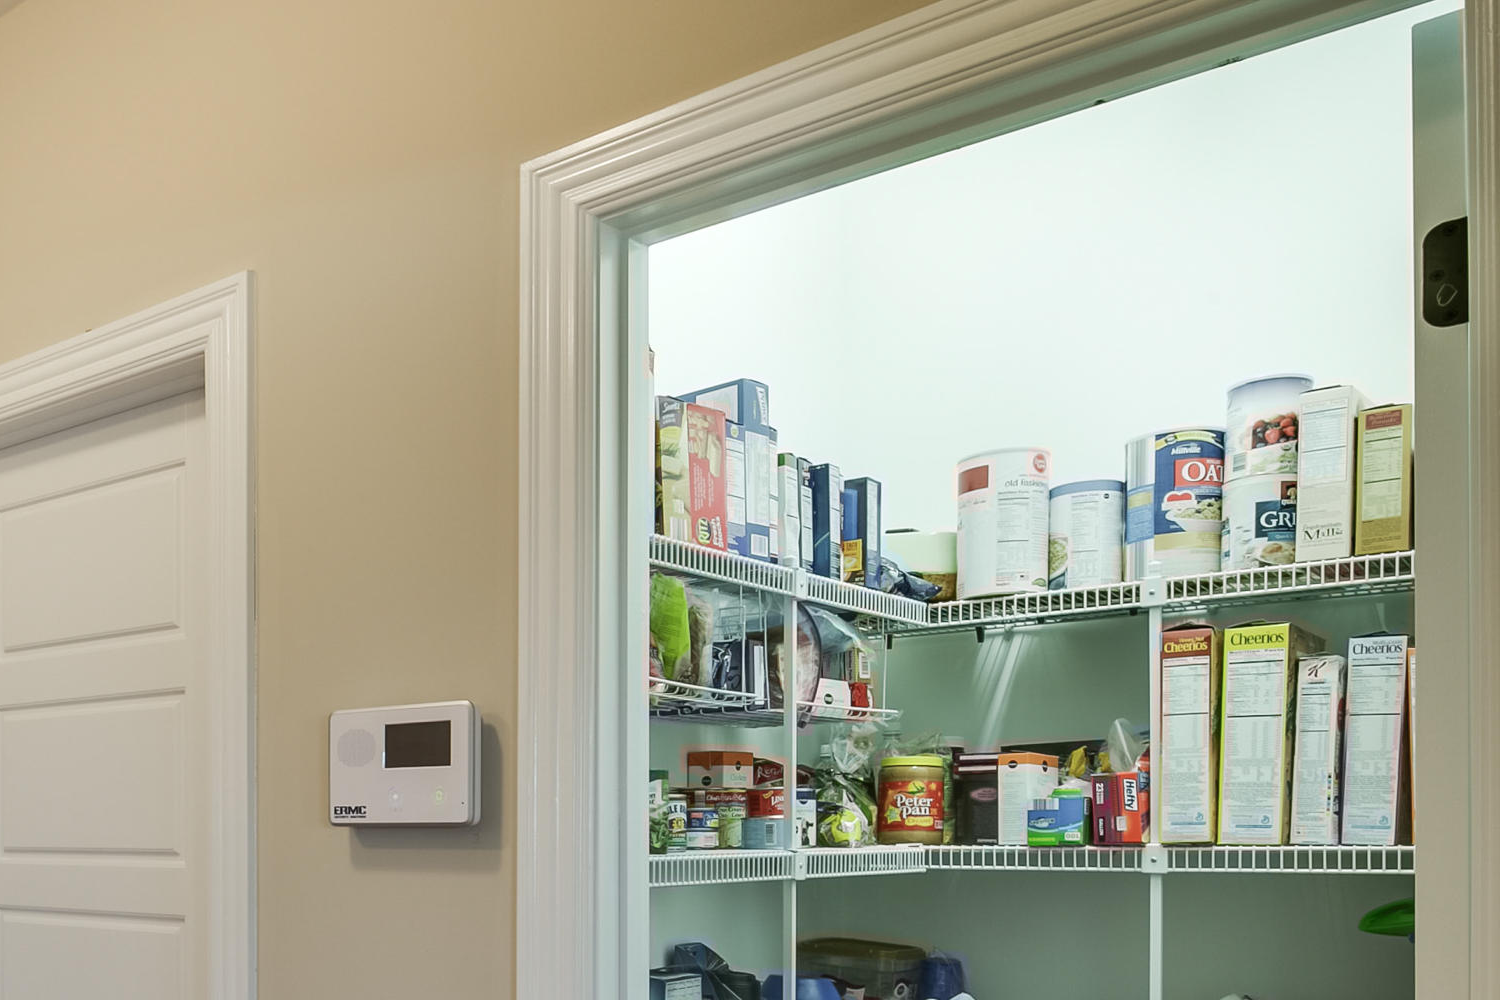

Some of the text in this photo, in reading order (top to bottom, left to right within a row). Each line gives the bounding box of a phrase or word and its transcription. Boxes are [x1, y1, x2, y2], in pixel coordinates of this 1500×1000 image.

[698, 518, 711, 545] RITZ
[1230, 631, 1284, 646] Cheerios
[1163, 641, 1208, 654] Cheerios
[1352, 642, 1403, 655] Cheerios
[893, 793, 935, 808] Peter
[1125, 780, 1137, 809] Hefty
[334, 806, 366, 815] ERMC
